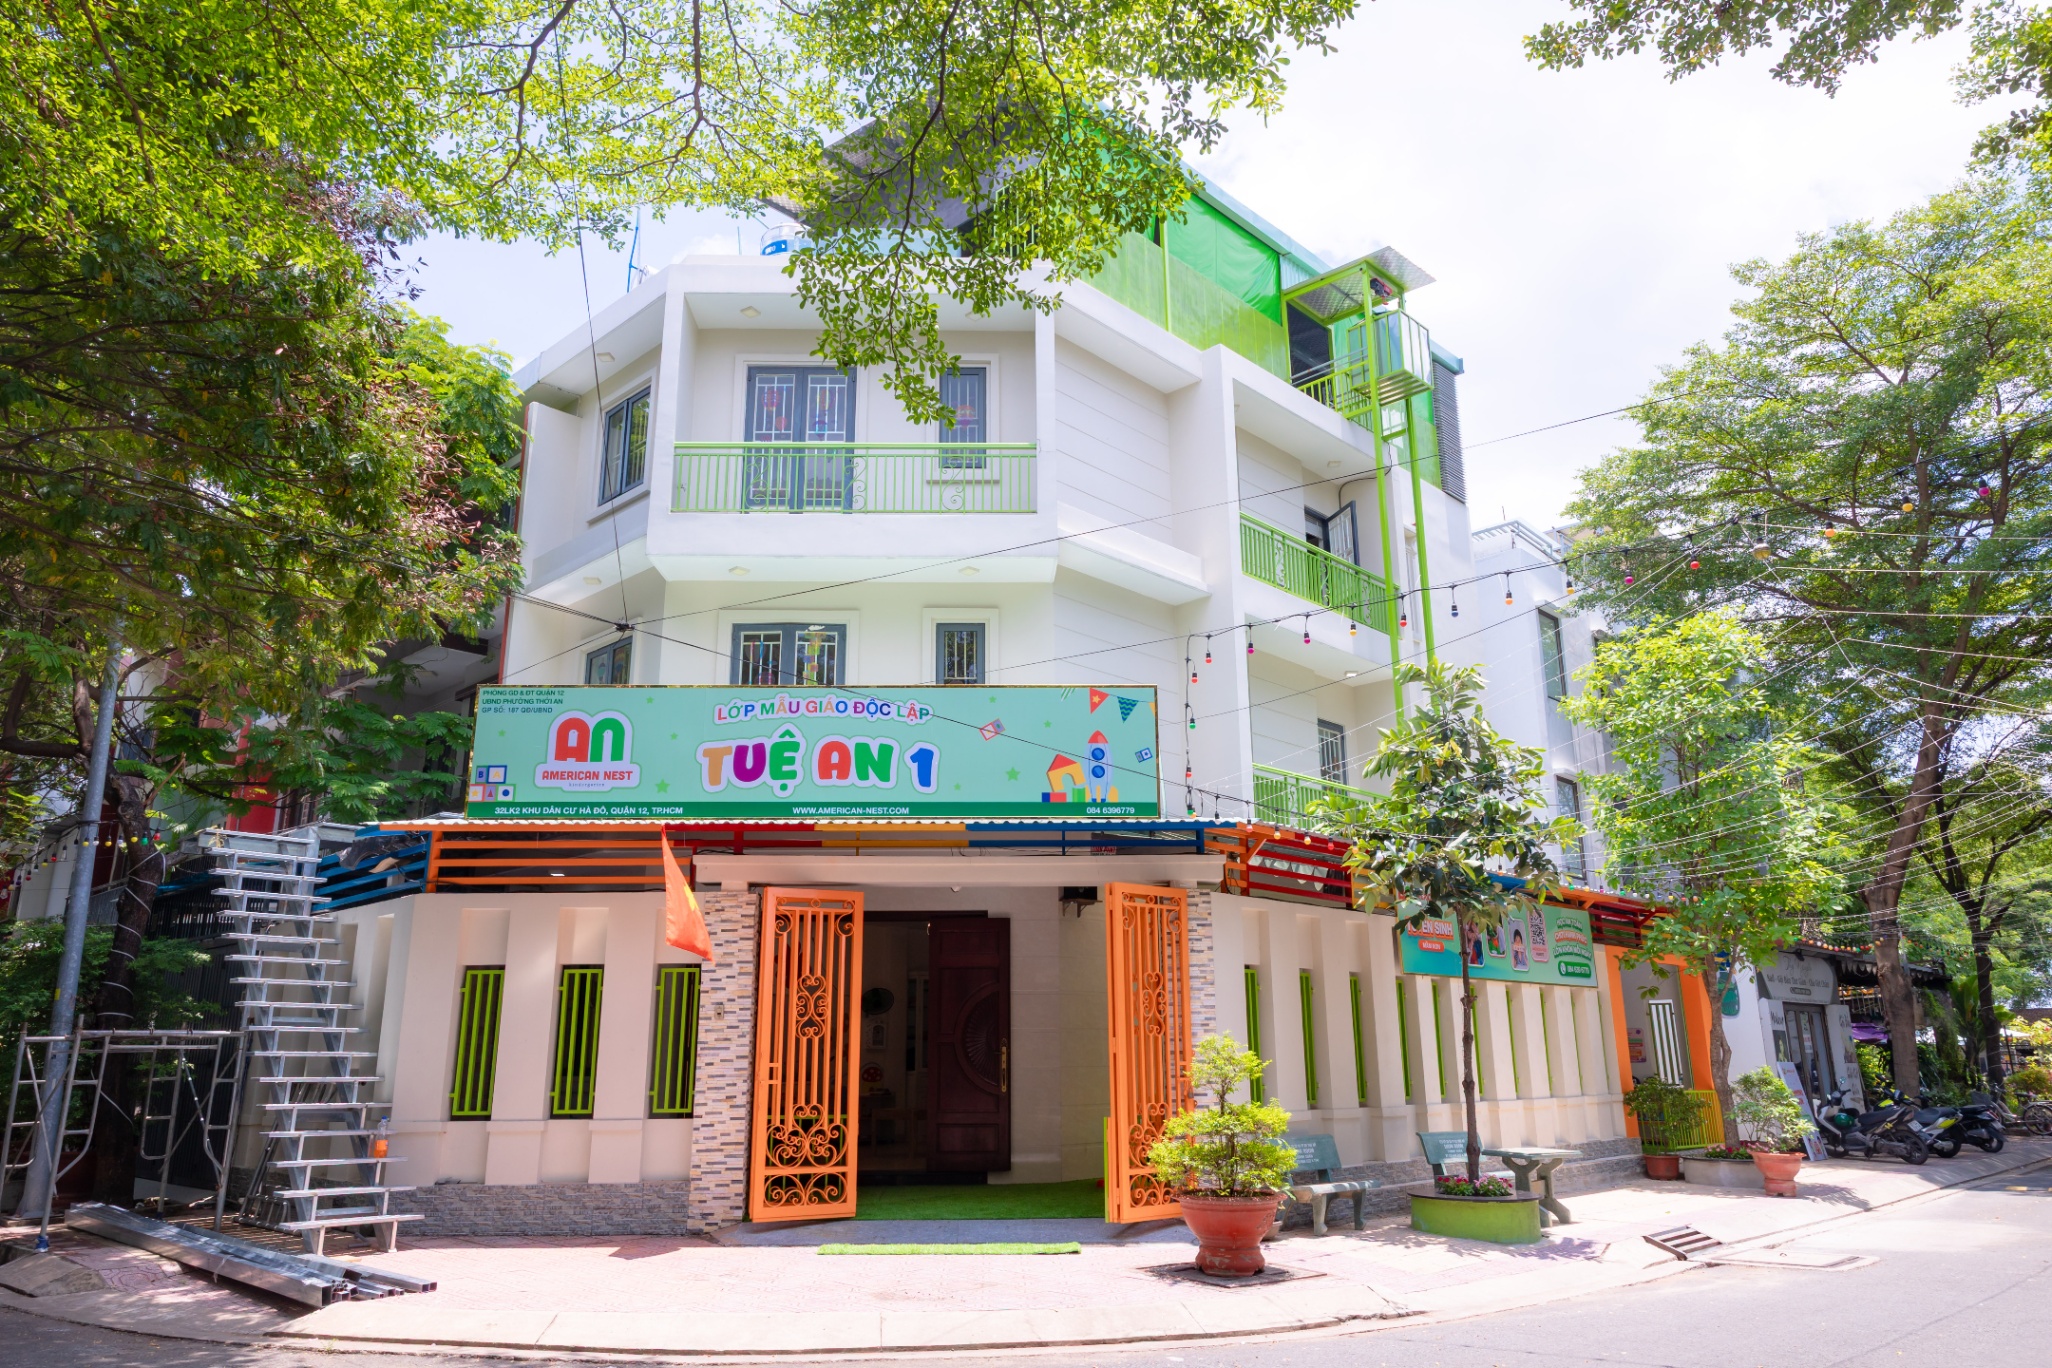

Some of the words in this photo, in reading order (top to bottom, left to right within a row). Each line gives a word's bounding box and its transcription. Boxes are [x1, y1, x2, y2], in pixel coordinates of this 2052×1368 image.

[536, 689, 556, 697] QUẬN
[494, 705, 505, 713] SỐ:
[717, 702, 755, 721] LỚP
[760, 696, 800, 716] MẪU
[805, 697, 848, 714] GIÁO
[853, 699, 891, 718] ĐỘC
[896, 702, 930, 721] LẬP
[702, 728, 800, 792] TUỆ
[818, 740, 894, 782] AN
[910, 747, 934, 788] 1
[493, 771, 501, 779] A
[542, 770, 600, 781] AMERICAN
[603, 770, 633, 781] NEST
[542, 805, 561, 814] DÂN
[563, 806, 578, 814] CƯ
[579, 805, 591, 814] HÀ
[593, 805, 609, 815] ĐÔ,
[610, 805, 636, 816] QUẬN
[638, 807, 650, 815] 12,
[1434, 920, 1454, 936] SINH
